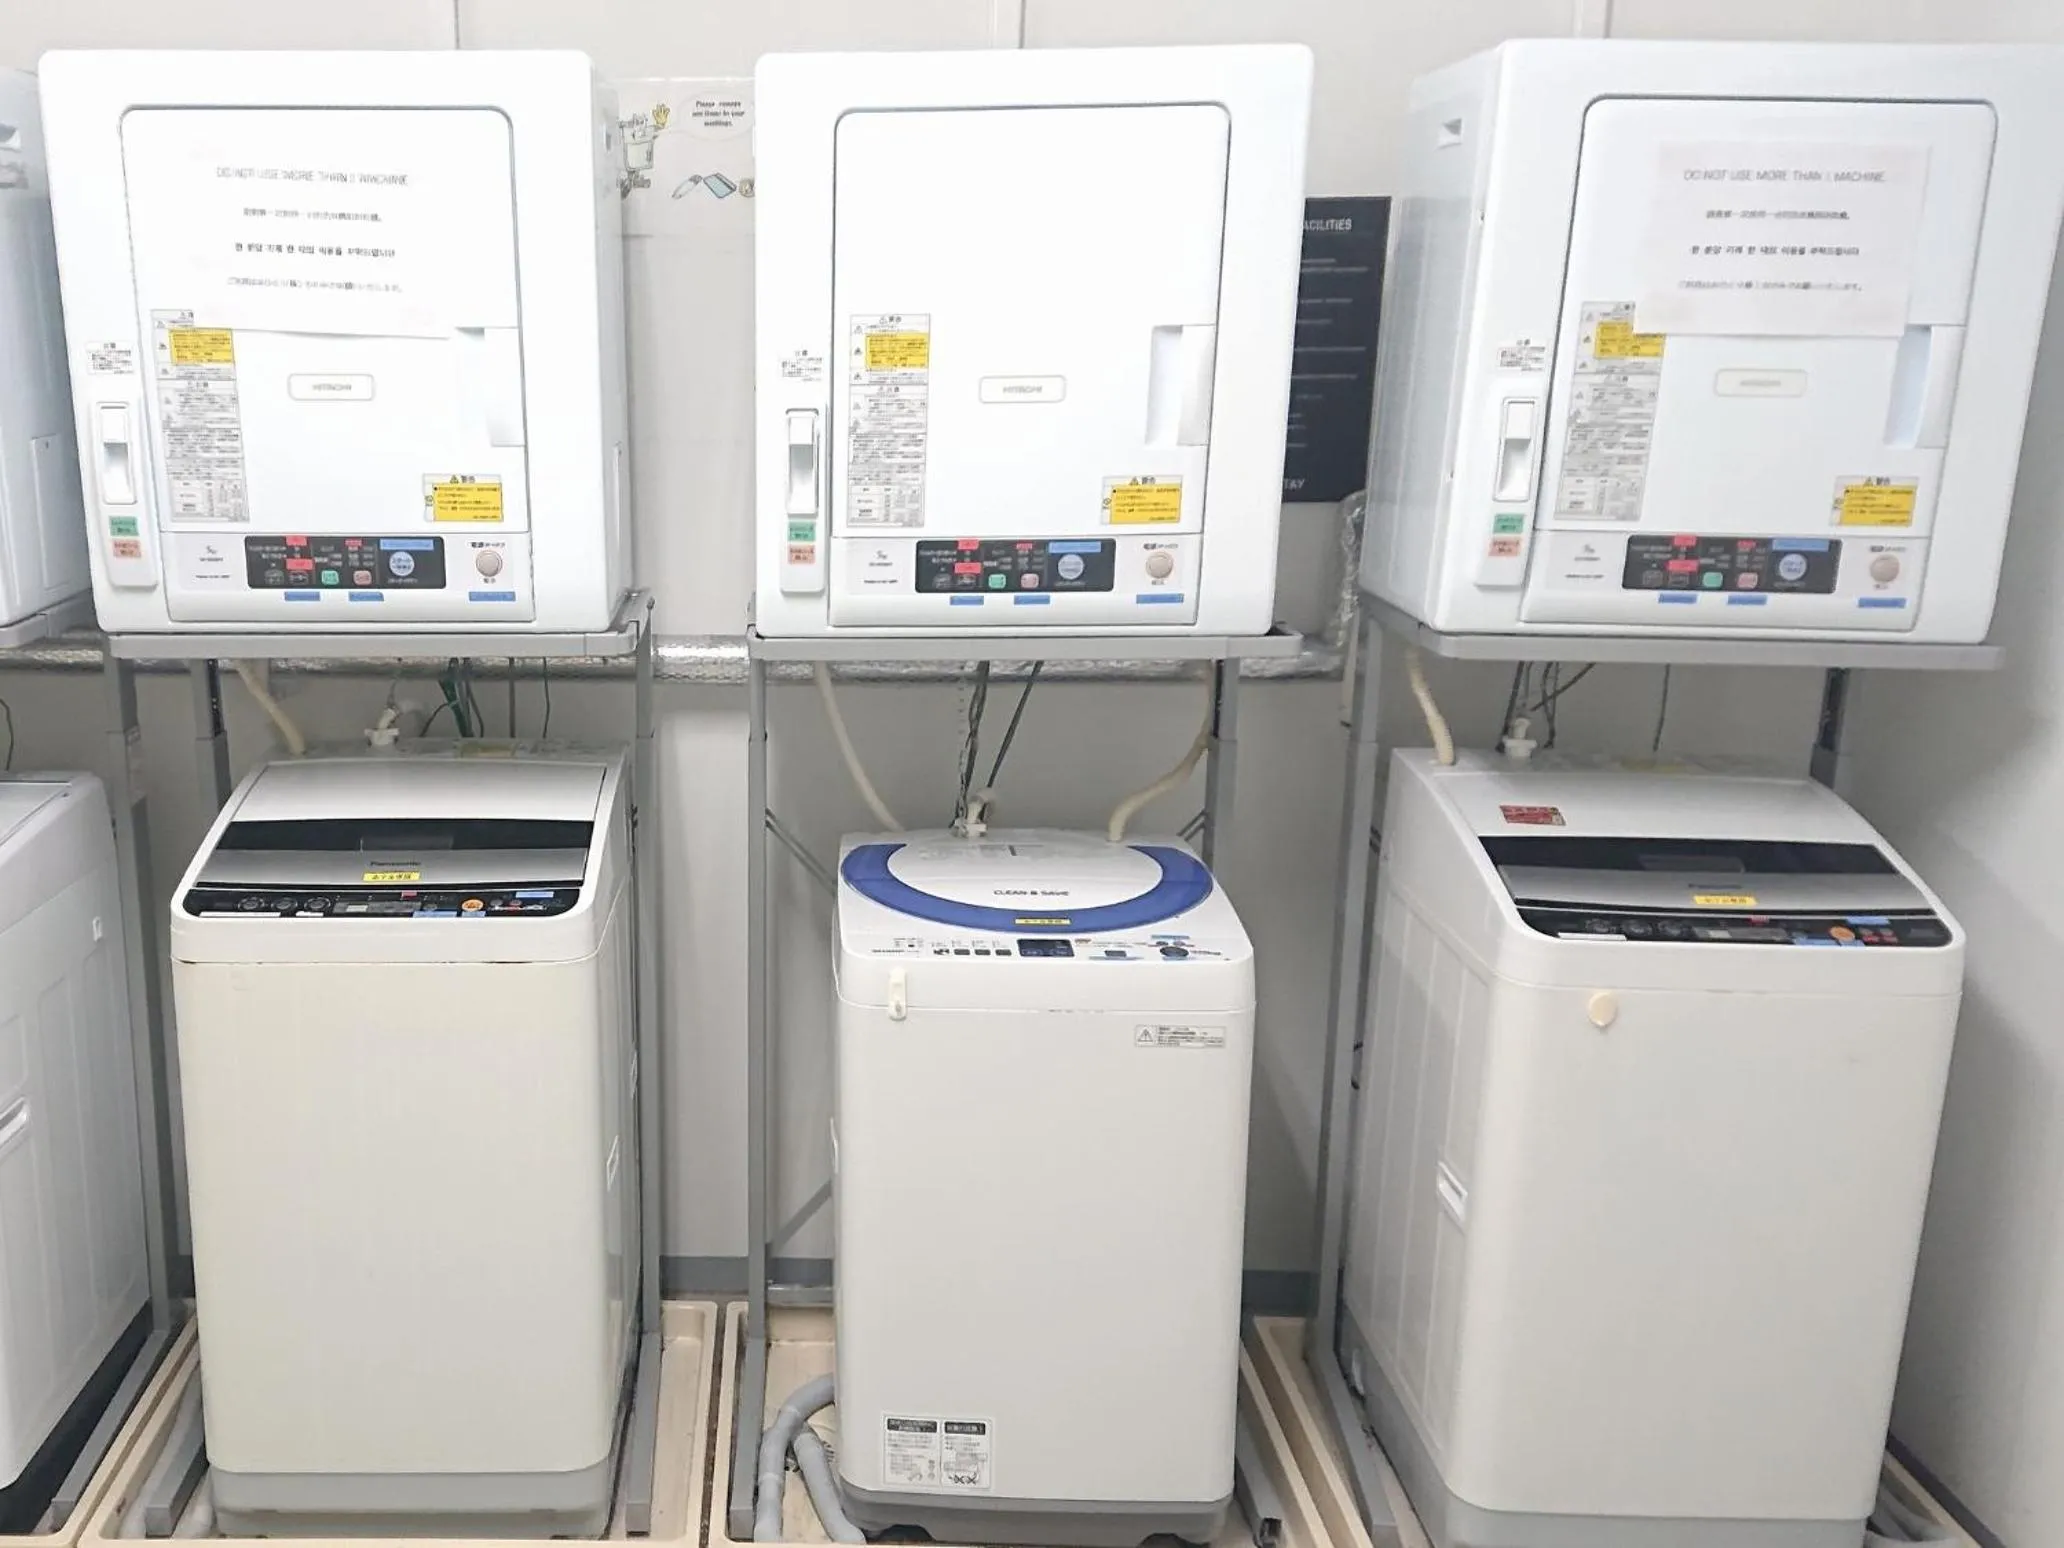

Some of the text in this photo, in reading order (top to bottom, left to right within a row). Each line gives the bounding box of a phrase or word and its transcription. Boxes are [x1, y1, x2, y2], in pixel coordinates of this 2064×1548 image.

[1683, 169, 1701, 182] DO
[1703, 169, 1728, 182] NOT
[1730, 169, 1753, 182] USE
[1756, 169, 1788, 182] MORE
[1793, 170, 1822, 182] THAN
